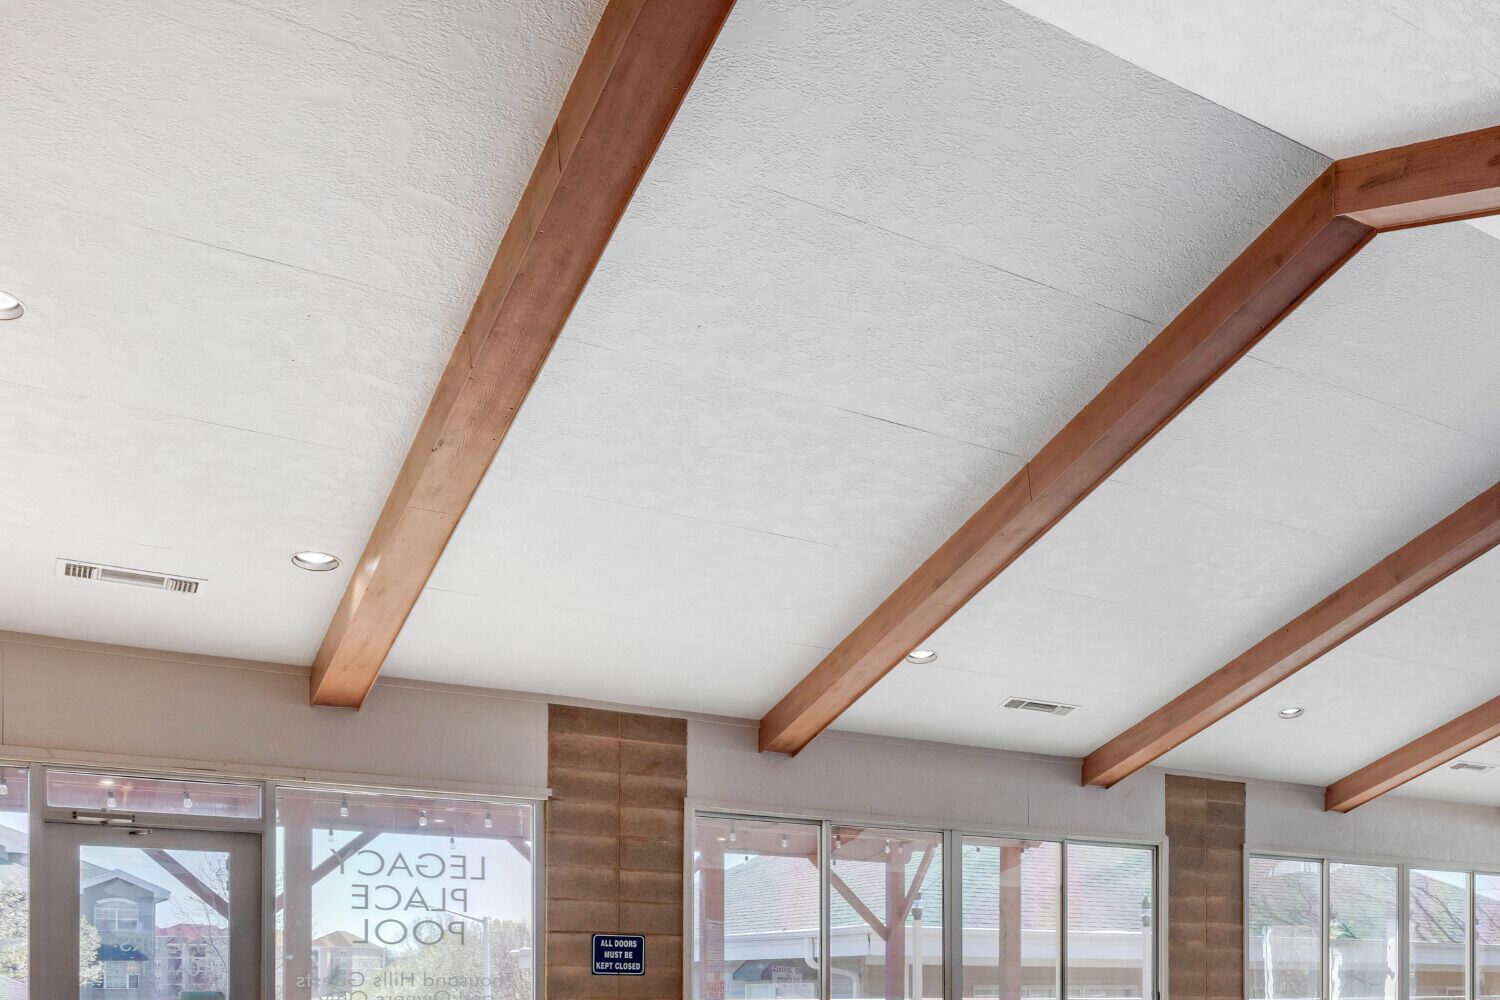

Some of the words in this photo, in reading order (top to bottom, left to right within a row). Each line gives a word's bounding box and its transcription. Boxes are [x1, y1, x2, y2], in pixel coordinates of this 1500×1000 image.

[600, 939, 613, 948] ALL
[614, 940, 638, 948] DOORS
[603, 950, 623, 959] MUST
[624, 951, 633, 959] BE
[595, 961, 614, 970] KEPT
[614, 962, 641, 971] CLOSED
